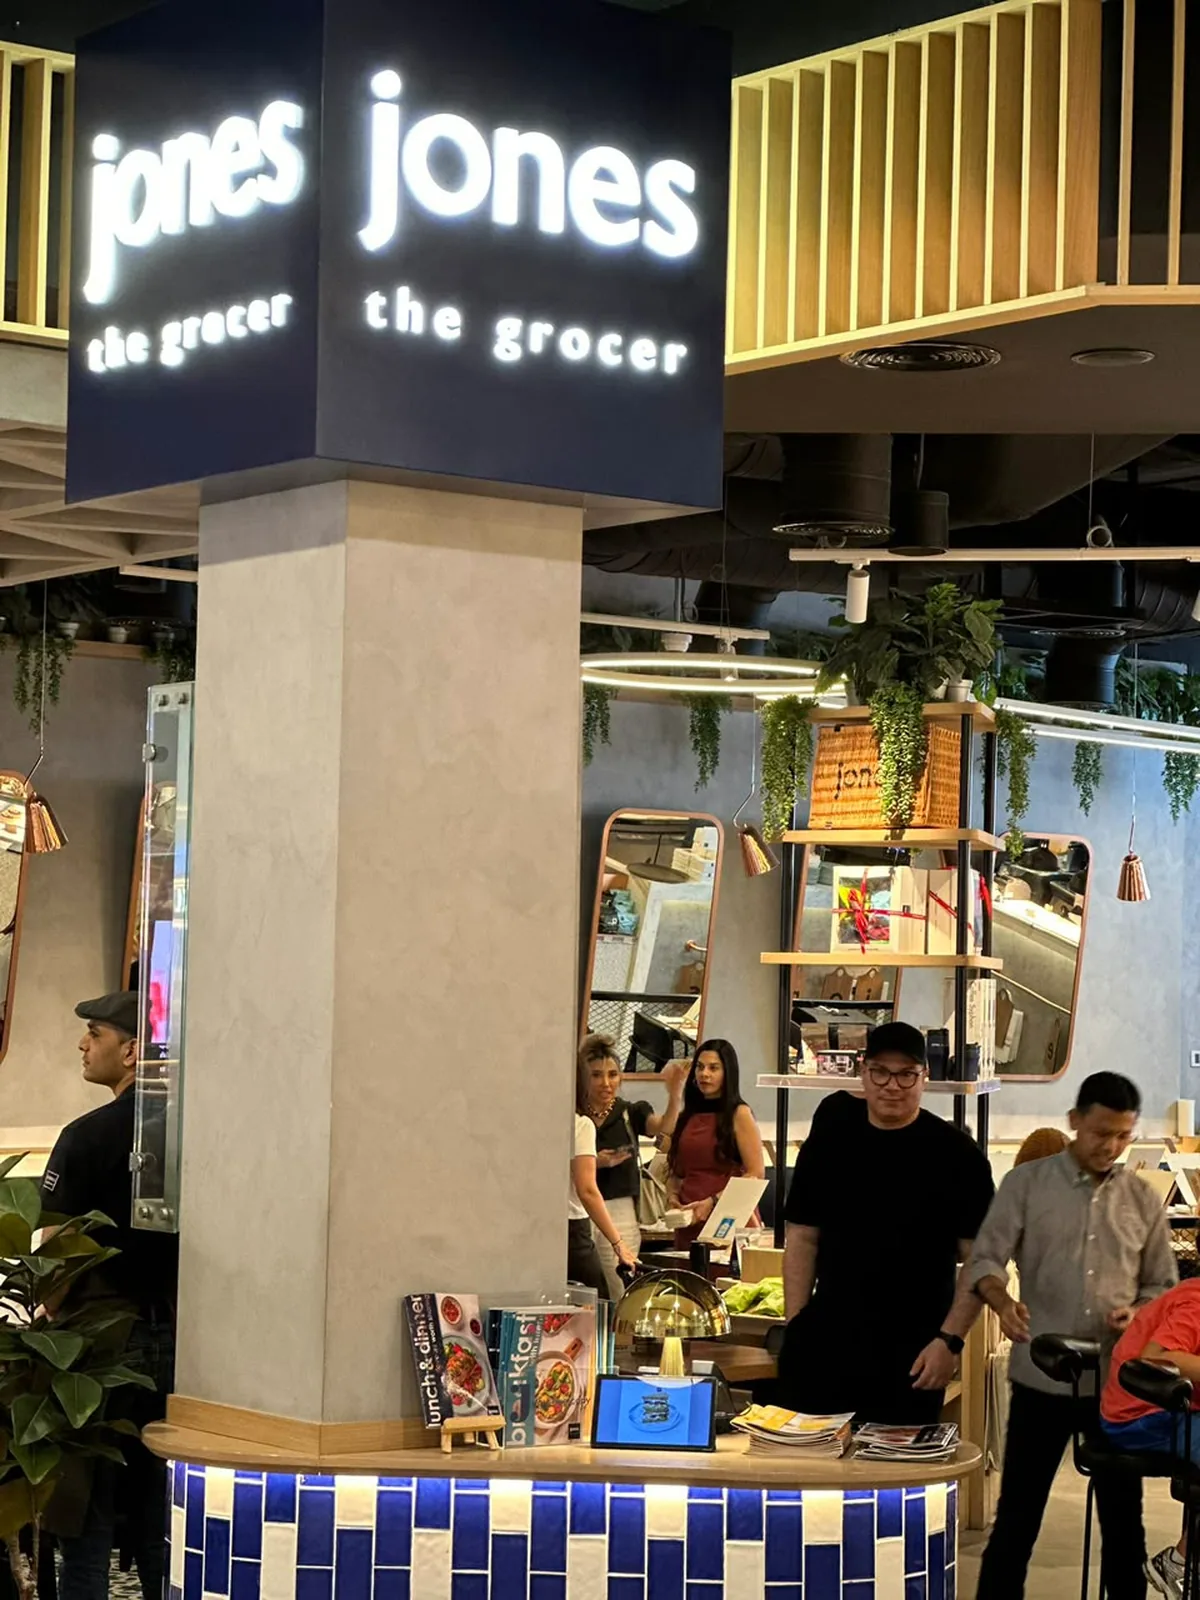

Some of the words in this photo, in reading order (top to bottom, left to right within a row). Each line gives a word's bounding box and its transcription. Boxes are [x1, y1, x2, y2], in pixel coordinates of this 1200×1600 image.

[83, 99, 304, 303] jones
[358, 70, 698, 258] jones
[87, 326, 149, 373] the
[160, 294, 292, 367] grocer
[365, 286, 461, 340] the
[493, 317, 687, 374] grocer
[410, 1294, 432, 1355] dinner
[419, 1358, 435, 1371] &
[421, 1374, 442, 1428] lunch
[506, 1311, 537, 1446] brkfast
